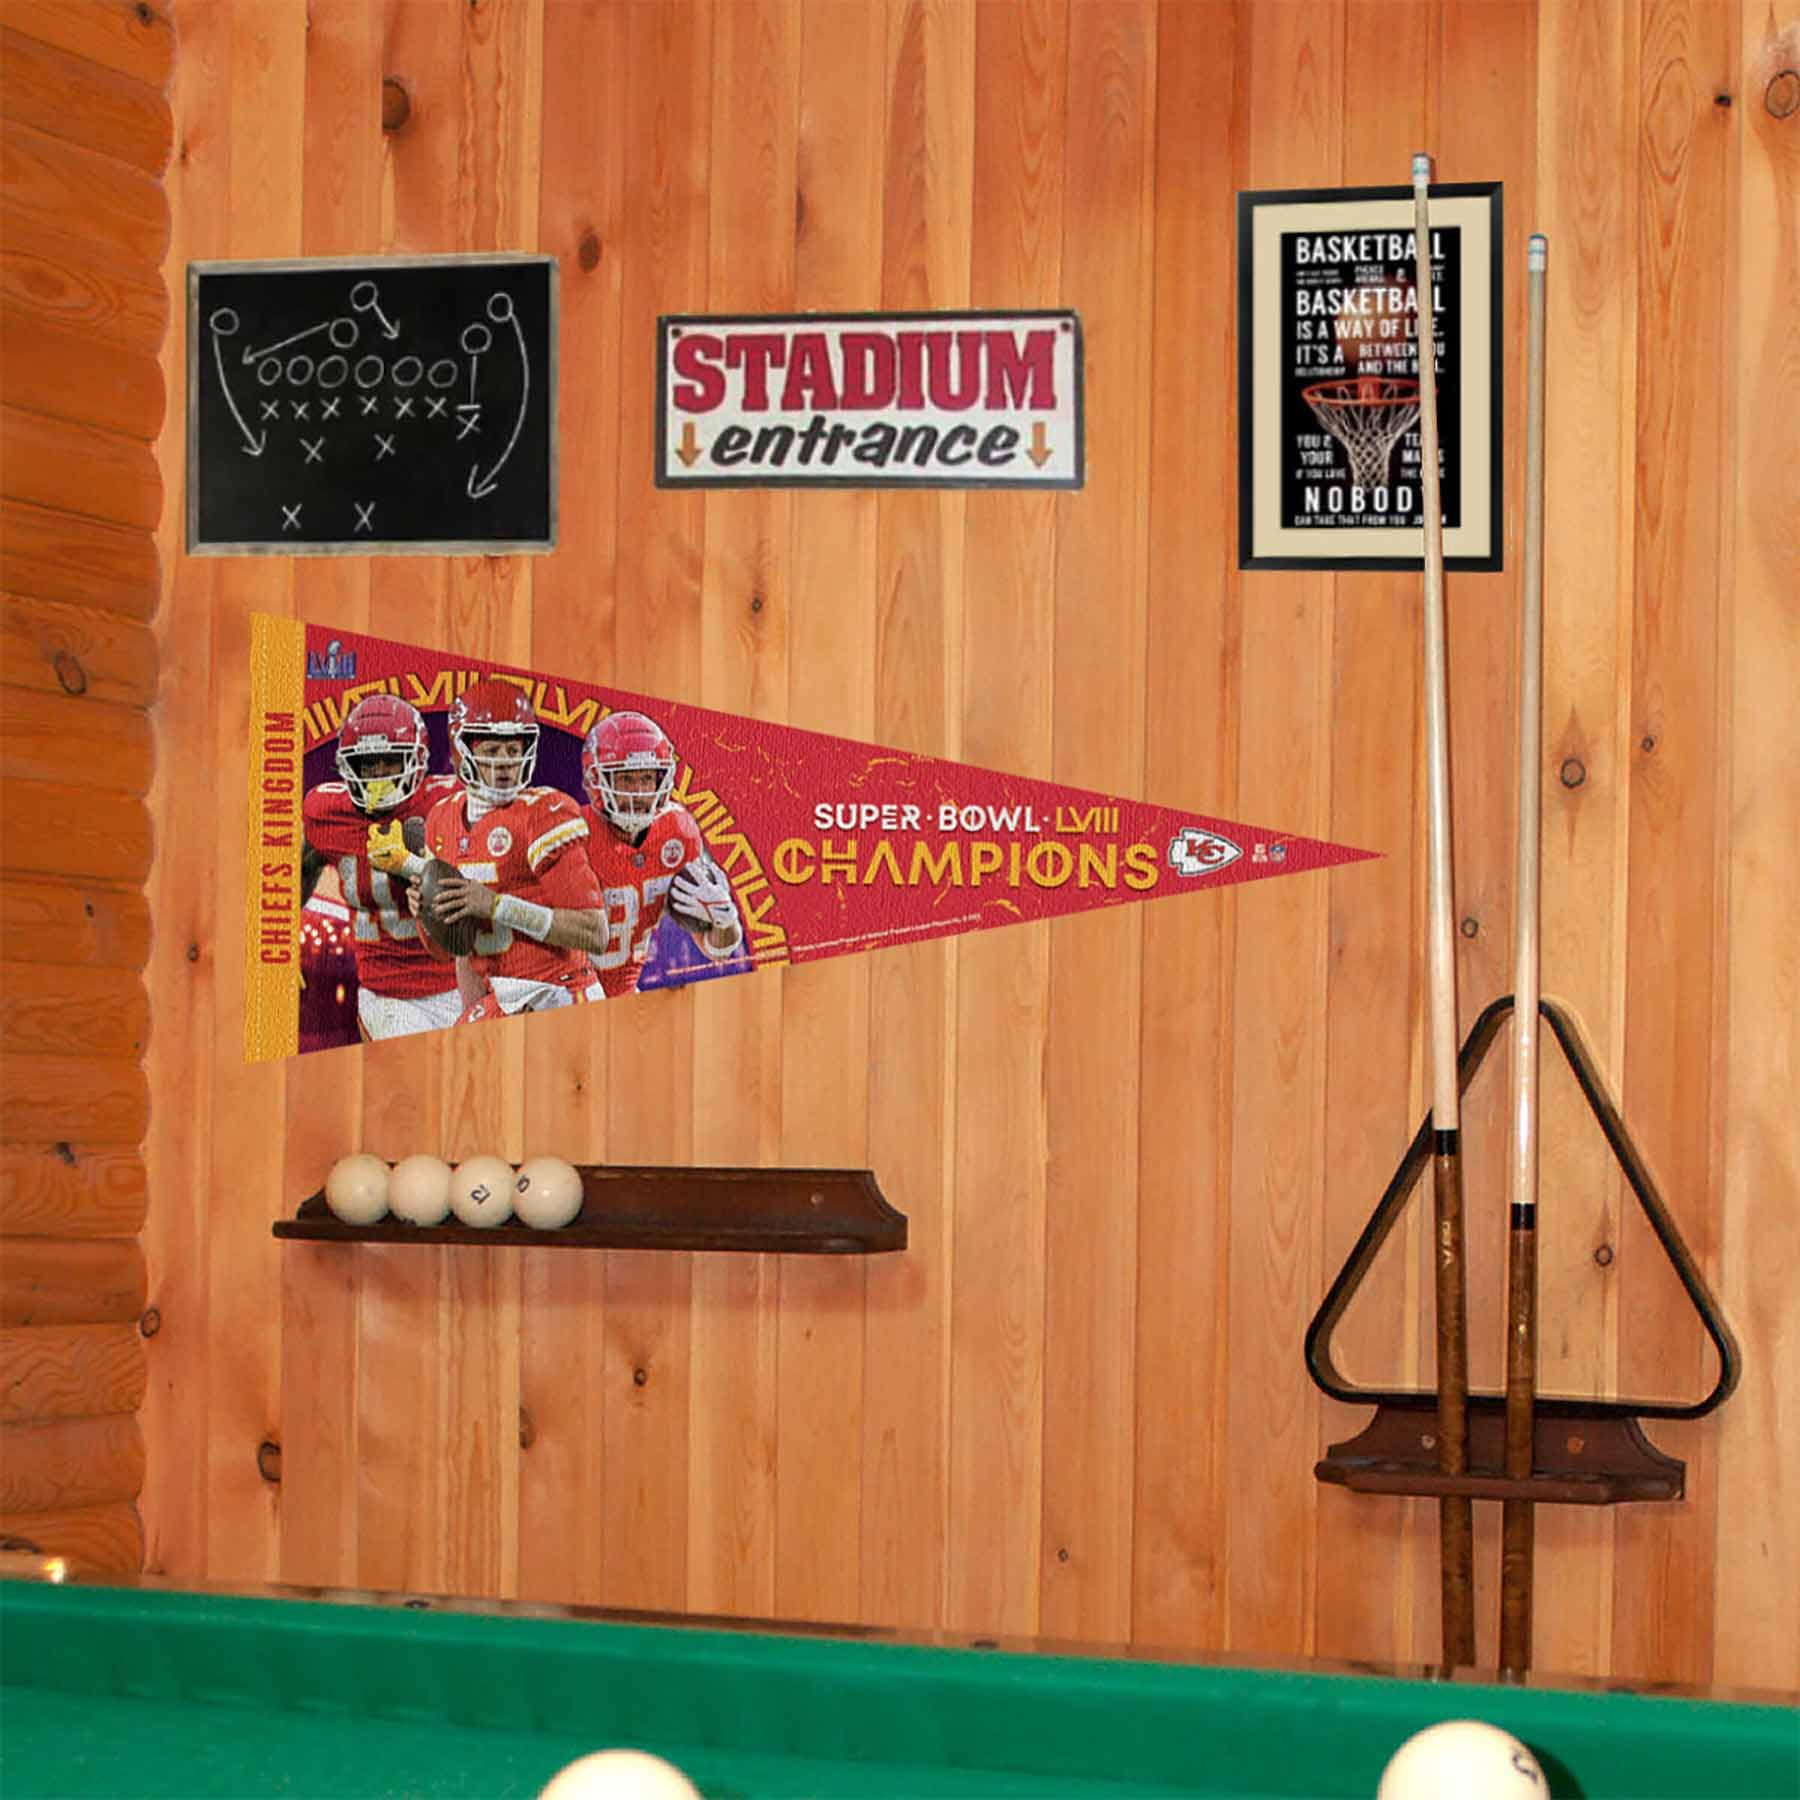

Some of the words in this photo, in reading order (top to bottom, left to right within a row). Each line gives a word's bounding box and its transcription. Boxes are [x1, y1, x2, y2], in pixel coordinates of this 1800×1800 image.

[1296, 232, 1446, 264] BASKETBAL
[1296, 285, 1446, 316] BASKETBAL
[1297, 320, 1313, 340] IS
[1317, 320, 1329, 339] A
[1333, 318, 1376, 339] WAY
[1380, 317, 1398, 337] OF
[1405, 317, 1445, 337] LIE.
[1296, 344, 1328, 365] IT'S
[1333, 344, 1344, 364] A
[672, 330, 1057, 413] STADIUM
[710, 415, 1020, 467] entrance
[1304, 485, 1424, 513] NOBOD
[262, 711, 296, 848] KINGDOM
[1055, 807, 1119, 834] LVIII
[772, 837, 1160, 892] CHAMPIONS
[260, 862, 293, 965] CHIEFS
